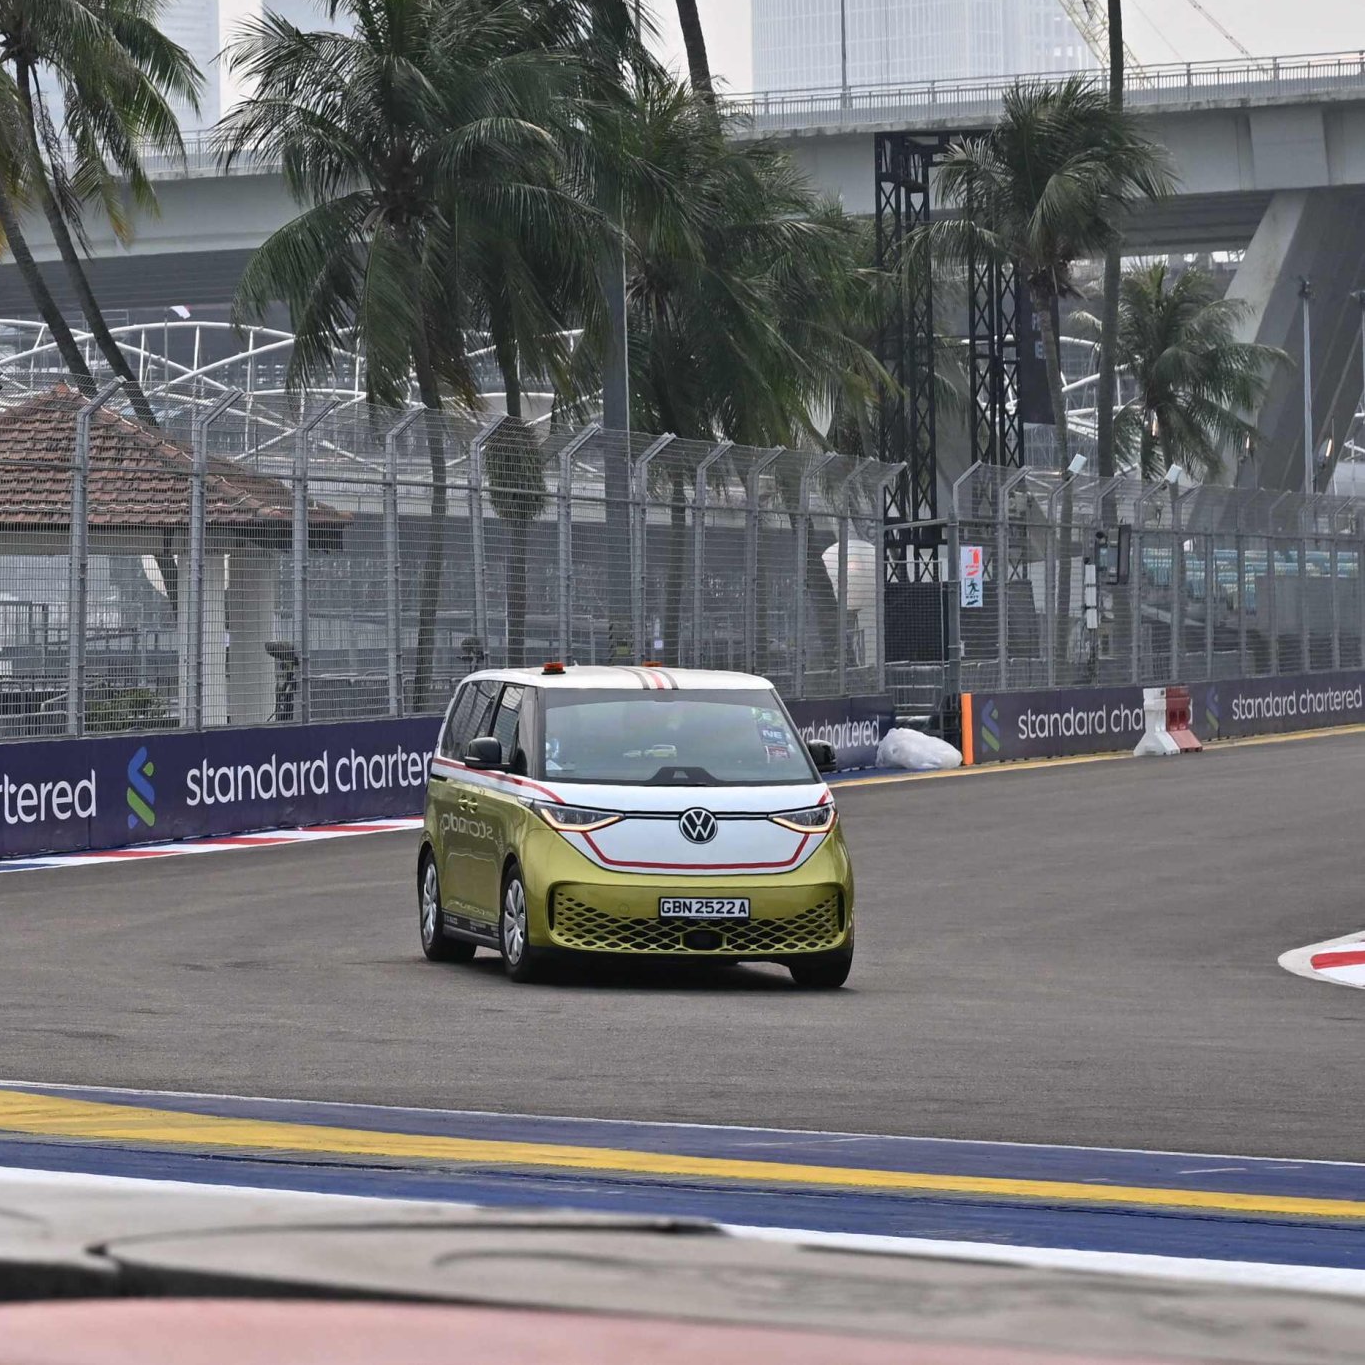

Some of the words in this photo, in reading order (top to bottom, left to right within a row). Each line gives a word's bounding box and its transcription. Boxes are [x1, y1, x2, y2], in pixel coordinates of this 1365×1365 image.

[1232, 691, 1296, 720] standard
[1298, 684, 1363, 714] chartered
[1017, 704, 1106, 739] standard
[186, 750, 328, 806] standard
[335, 745, 433, 792] charter
